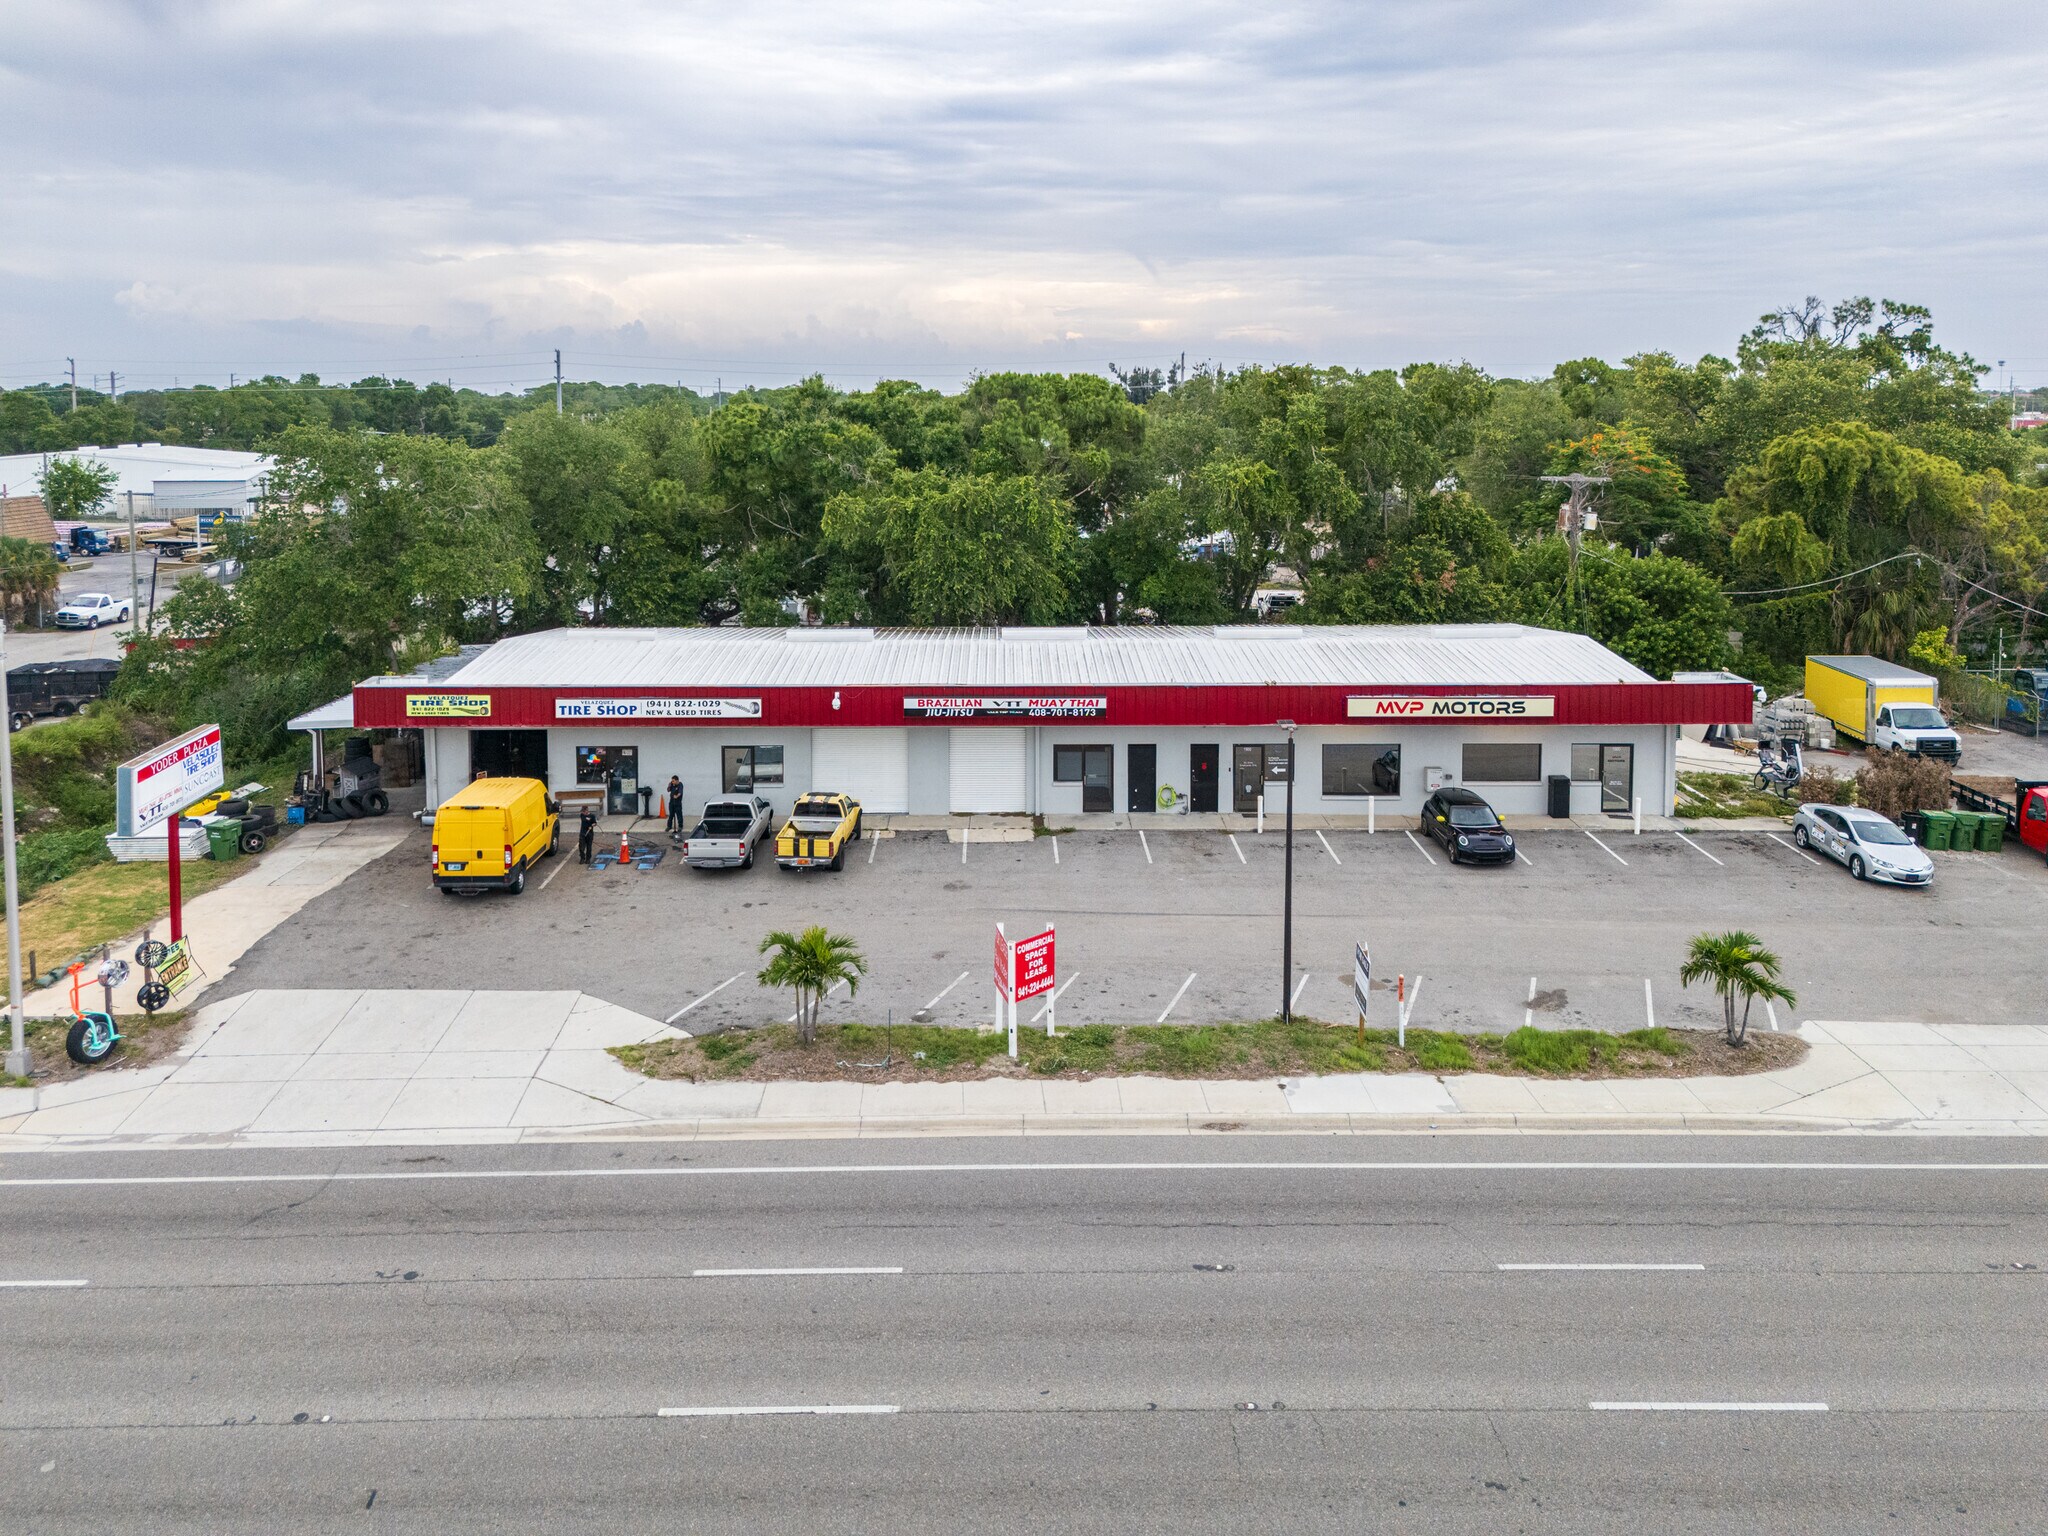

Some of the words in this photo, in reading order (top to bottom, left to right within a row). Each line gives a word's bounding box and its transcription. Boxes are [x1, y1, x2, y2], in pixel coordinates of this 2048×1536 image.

[558, 705, 591, 716] TIRE
[597, 705, 638, 716] SHOP
[646, 700, 671, 708] (941)
[674, 700, 721, 708] 822-1029
[917, 699, 982, 708] BRAZILIAN
[1028, 699, 1067, 708] MUAY
[1070, 699, 1100, 708] THAI
[1375, 701, 1424, 714] MVP
[1432, 701, 1526, 714] MOTORS
[925, 708, 974, 717] JIU-JITSU
[1028, 708, 1096, 717] 408-701-8173
[150, 752, 178, 775] YODER
[183, 737, 208, 758] PLAZA
[182, 743, 219, 769] VELASQUEZ
[186, 763, 201, 776] TIRE
[200, 753, 217, 769] SHOP
[184, 766, 220, 793] SUNCOAST
[1017, 934, 1054, 954] COMMERCIAL
[1025, 946, 1047, 961] SPACE
[1029, 958, 1043, 969] FOR
[1025, 965, 1047, 980] LEASE
[1018, 975, 1054, 998] 941-224-4444
